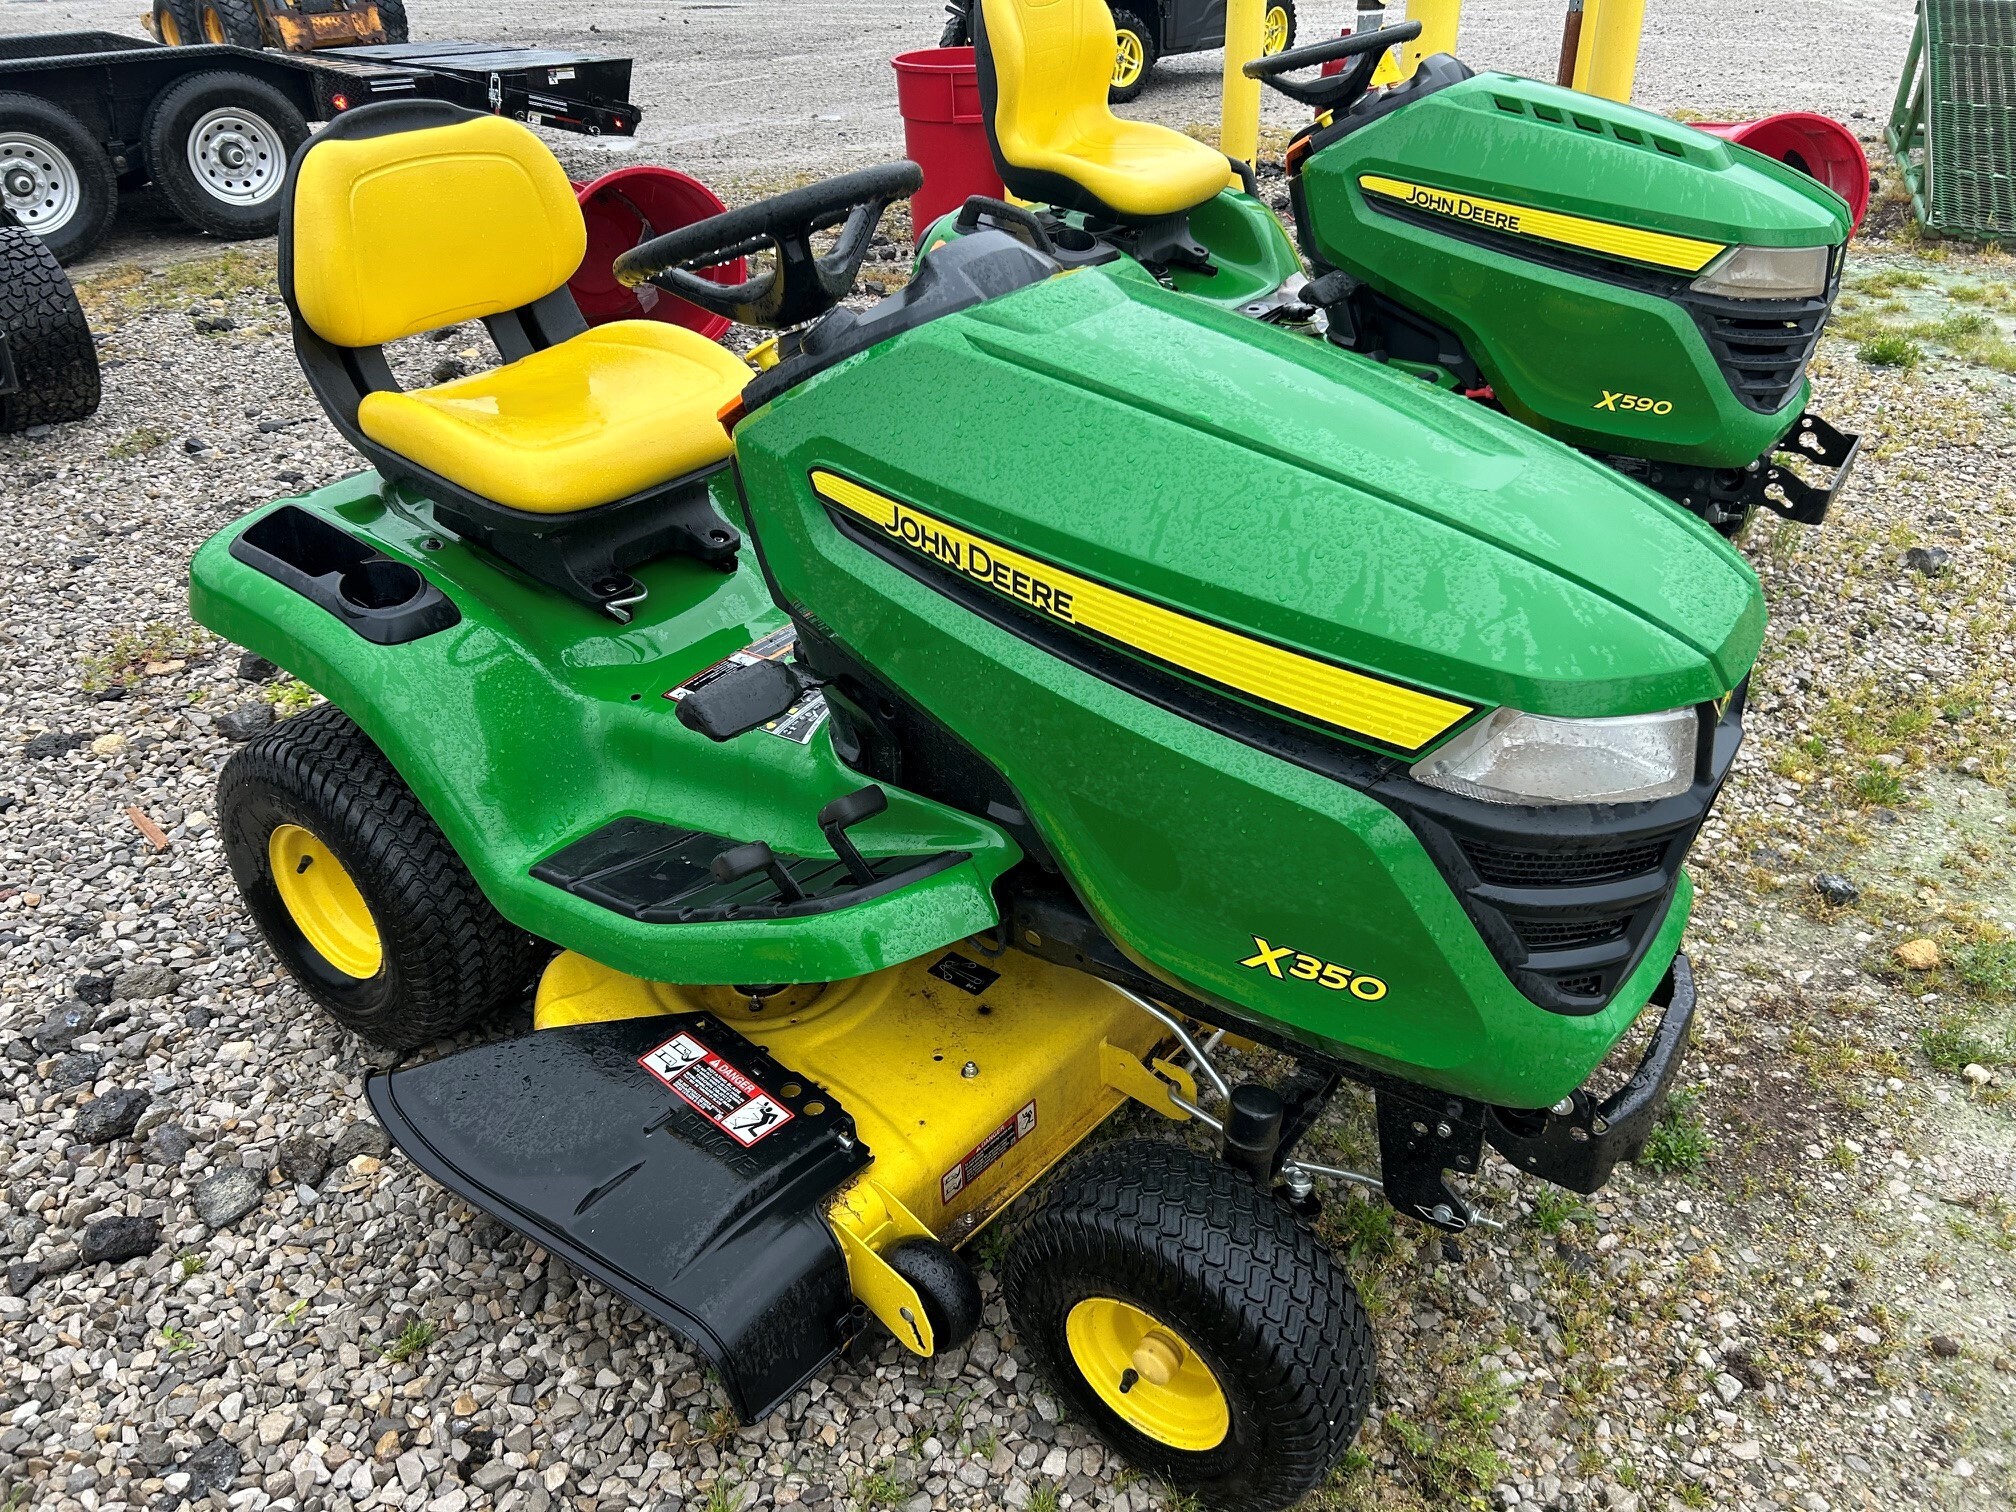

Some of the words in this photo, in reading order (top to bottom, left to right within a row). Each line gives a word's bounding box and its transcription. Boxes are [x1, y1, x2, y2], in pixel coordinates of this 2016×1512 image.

[1405, 186, 1455, 213] JOHN
[1458, 199, 1521, 231] DEERE
[1592, 390, 1674, 416] X590
[884, 505, 961, 567] JOHN
[968, 542, 1074, 620] DEERE
[1236, 934, 1389, 1002] X350
[717, 1064, 756, 1093] DANGER
